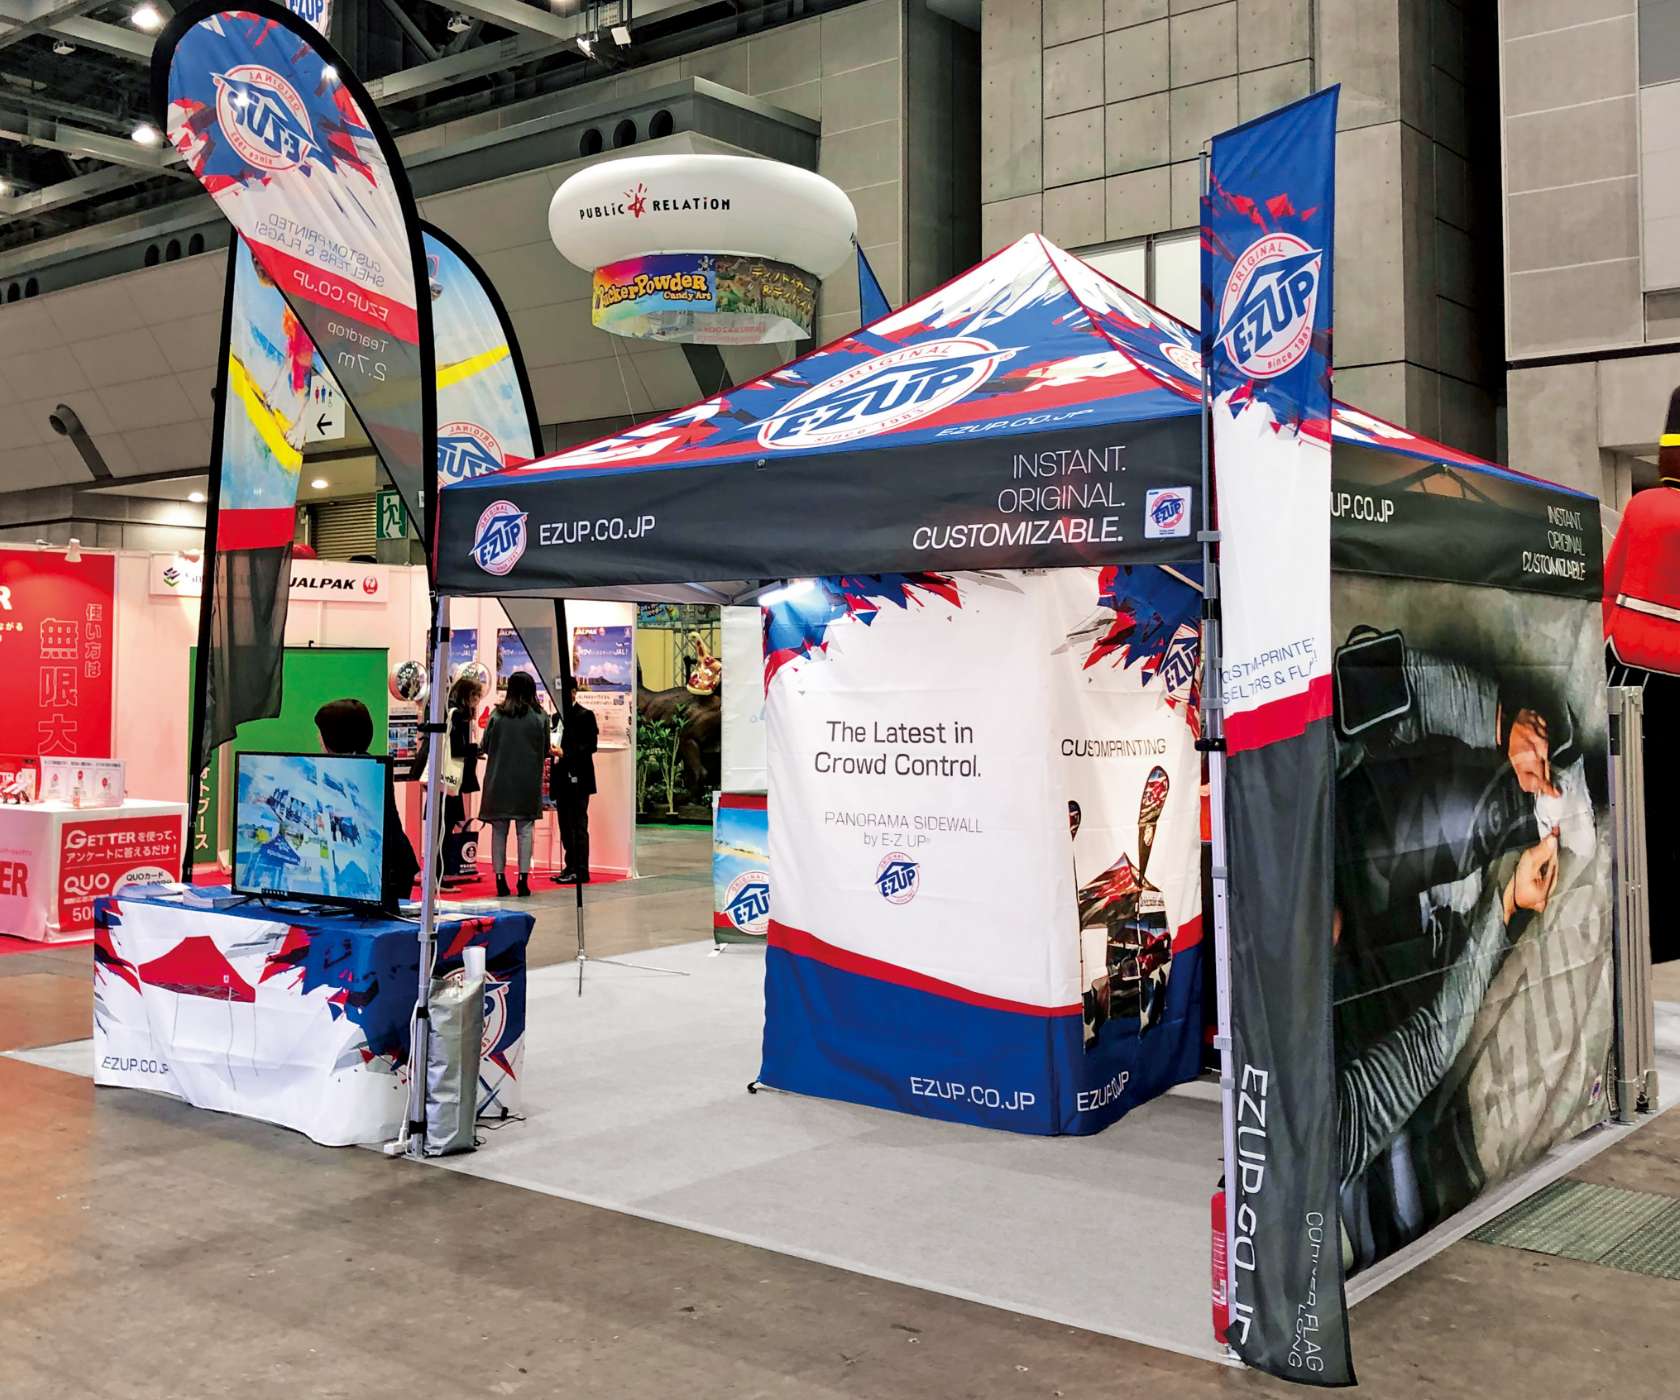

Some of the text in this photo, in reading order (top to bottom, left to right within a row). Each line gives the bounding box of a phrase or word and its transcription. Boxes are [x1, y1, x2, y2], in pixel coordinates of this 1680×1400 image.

[1231, 241, 1284, 293] ORIGINAL
[829, 344, 952, 388] ORIGINAL
[1267, 351, 1293, 369] since
[814, 406, 925, 443] since 1983
[936, 408, 1095, 437] EZUP.CO.JP
[1012, 446, 1127, 480] INSTANT.
[997, 486, 1127, 514] ORIGINAL.
[1331, 491, 1395, 523] UP.CO.JP
[539, 515, 656, 546] EZUP.CO.JP
[912, 517, 1124, 551] CUSTOMIZABLE.
[289, 576, 357, 592] JALPAK
[84, 603, 103, 678] 使い方は
[38, 616, 79, 756] 無限大
[1273, 670, 1286, 685] &
[826, 720, 974, 744] The Latest in
[814, 751, 982, 778] Crowd Control.
[824, 811, 984, 834] PANORAMA SIDEWALL
[863, 832, 878, 847] by
[881, 832, 903, 847] E-Z
[63, 873, 110, 896] QUO
[72, 906, 95, 922] 50
[910, 1076, 1035, 1111] EZUP.CO.JP
[1287, 1303, 1306, 1369] LONG
[1303, 1313, 1324, 1372] FLAG
